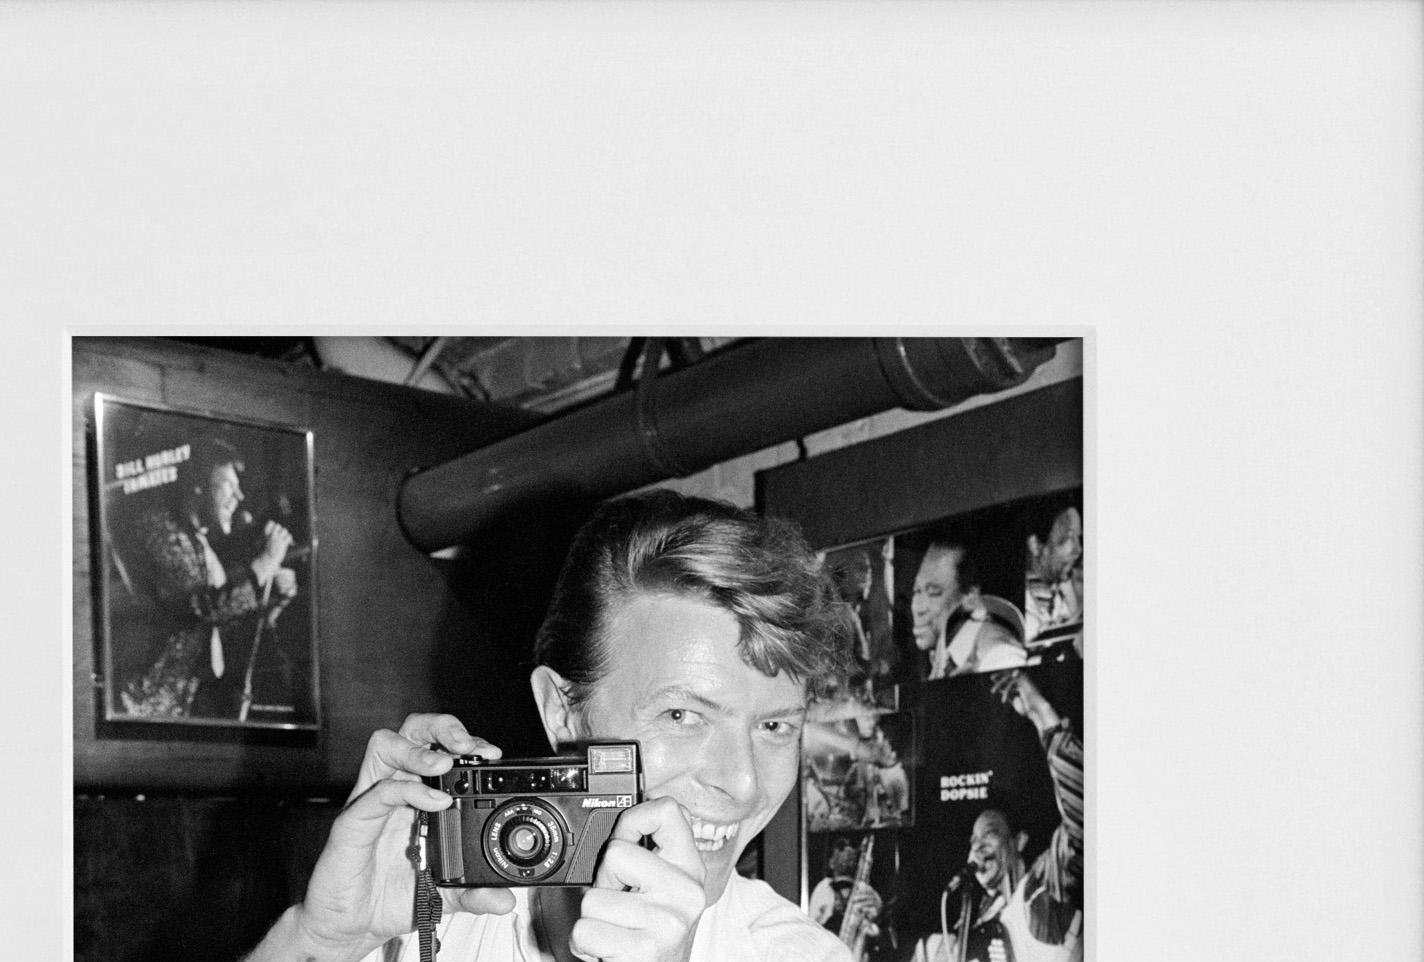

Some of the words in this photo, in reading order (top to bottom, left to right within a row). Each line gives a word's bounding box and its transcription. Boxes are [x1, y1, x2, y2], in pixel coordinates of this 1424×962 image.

[940, 770, 993, 788] ROCKIN'
[582, 798, 616, 807] Nikon
[940, 787, 988, 801] DOPSIE
[490, 822, 502, 841] LENS
[492, 847, 509, 869] Nikon
